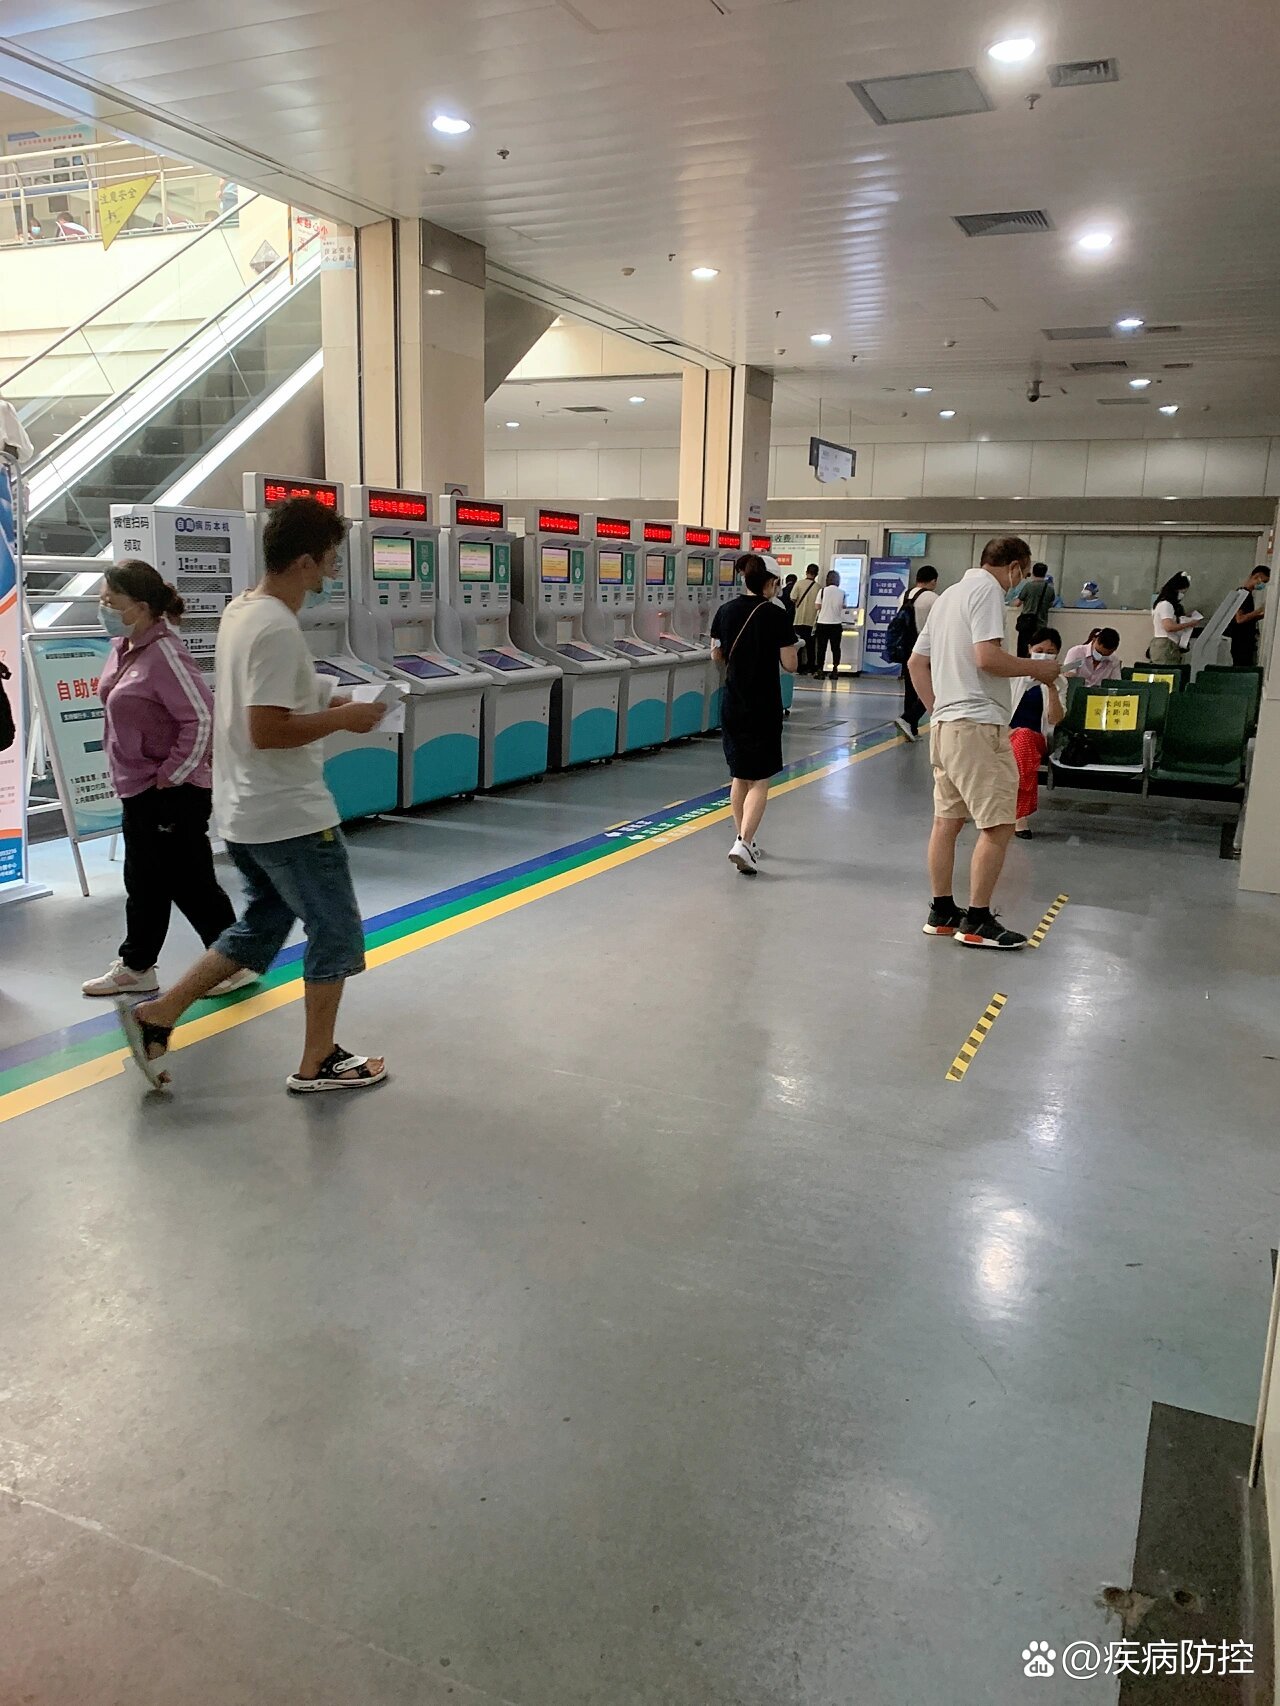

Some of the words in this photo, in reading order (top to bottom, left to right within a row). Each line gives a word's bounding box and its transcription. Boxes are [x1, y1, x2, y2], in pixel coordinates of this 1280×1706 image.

[113, 516, 149, 529] 微信扫码
[123, 539, 142, 552] 领取
